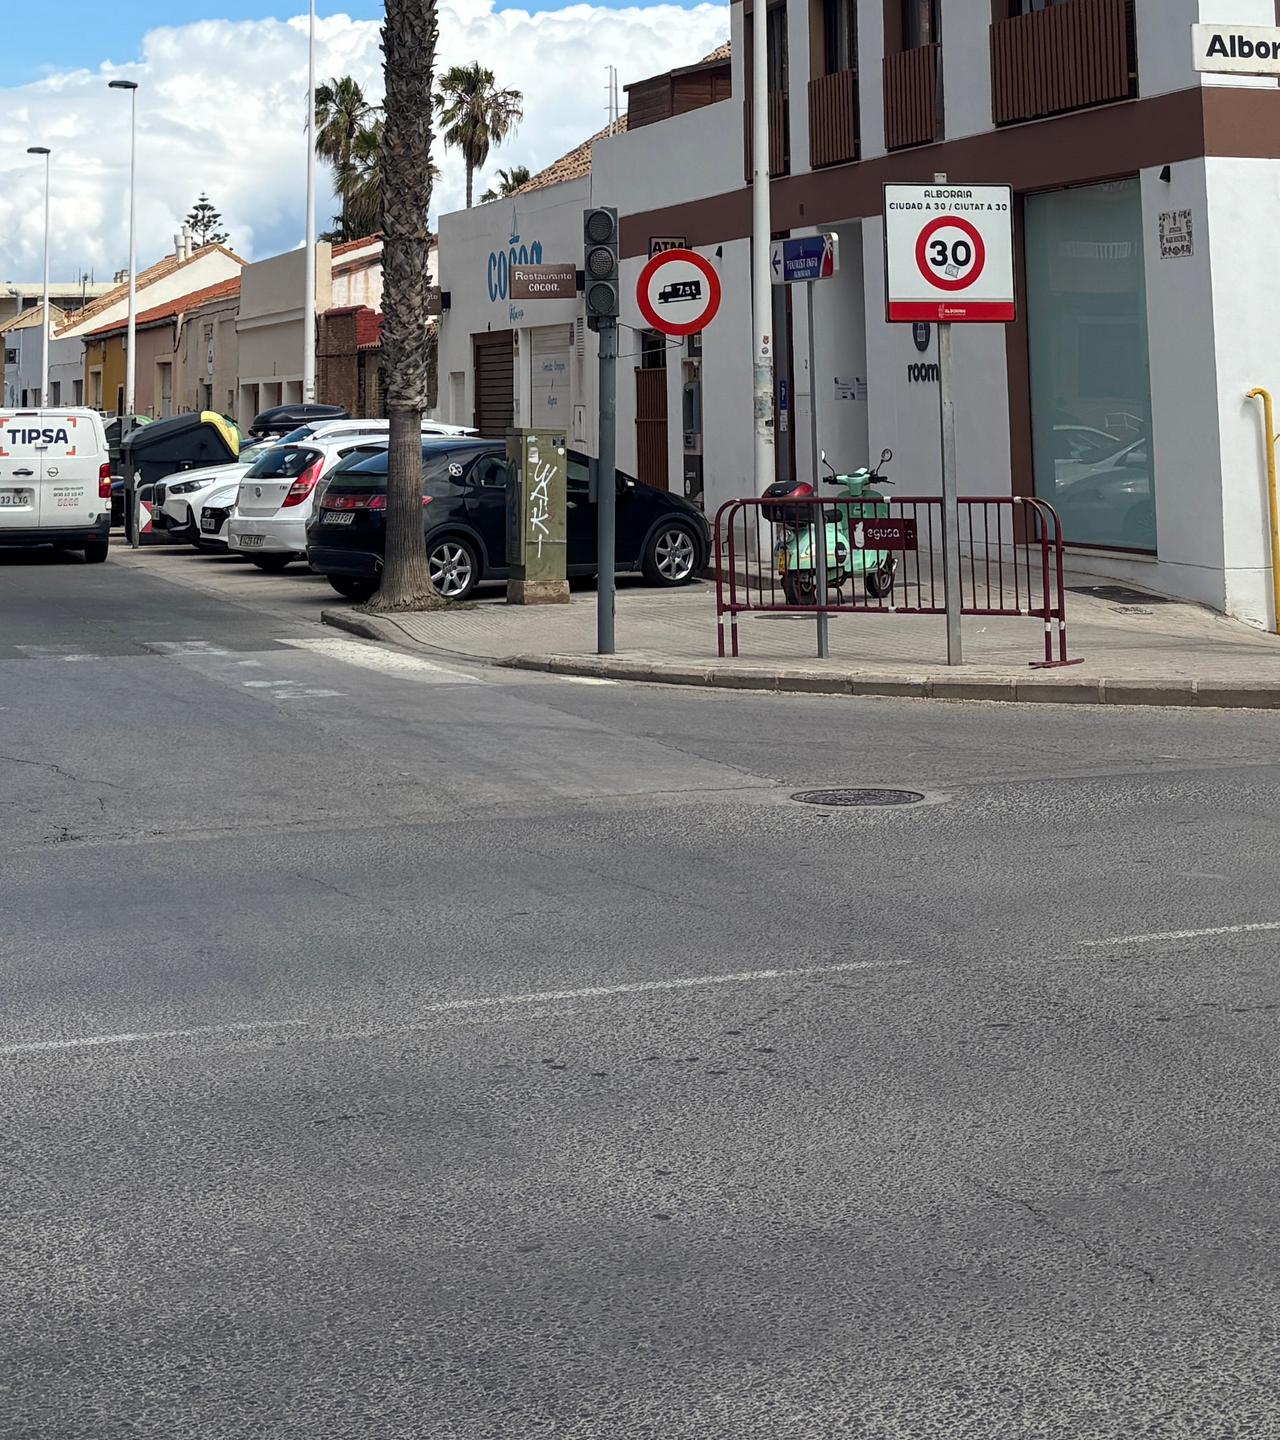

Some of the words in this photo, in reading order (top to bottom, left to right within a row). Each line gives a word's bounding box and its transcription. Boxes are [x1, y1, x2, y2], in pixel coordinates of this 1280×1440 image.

[924, 190, 972, 198] ALBORAIA
[954, 203, 984, 211] CIUTAT
[995, 203, 1007, 211] 30
[653, 241, 683, 253] ATM
[929, 240, 971, 266] 30
[515, 271, 572, 280] Restaurante
[908, 362, 939, 382] room
[7, 428, 69, 445] TIPSA
[867, 528, 900, 540] egusa
